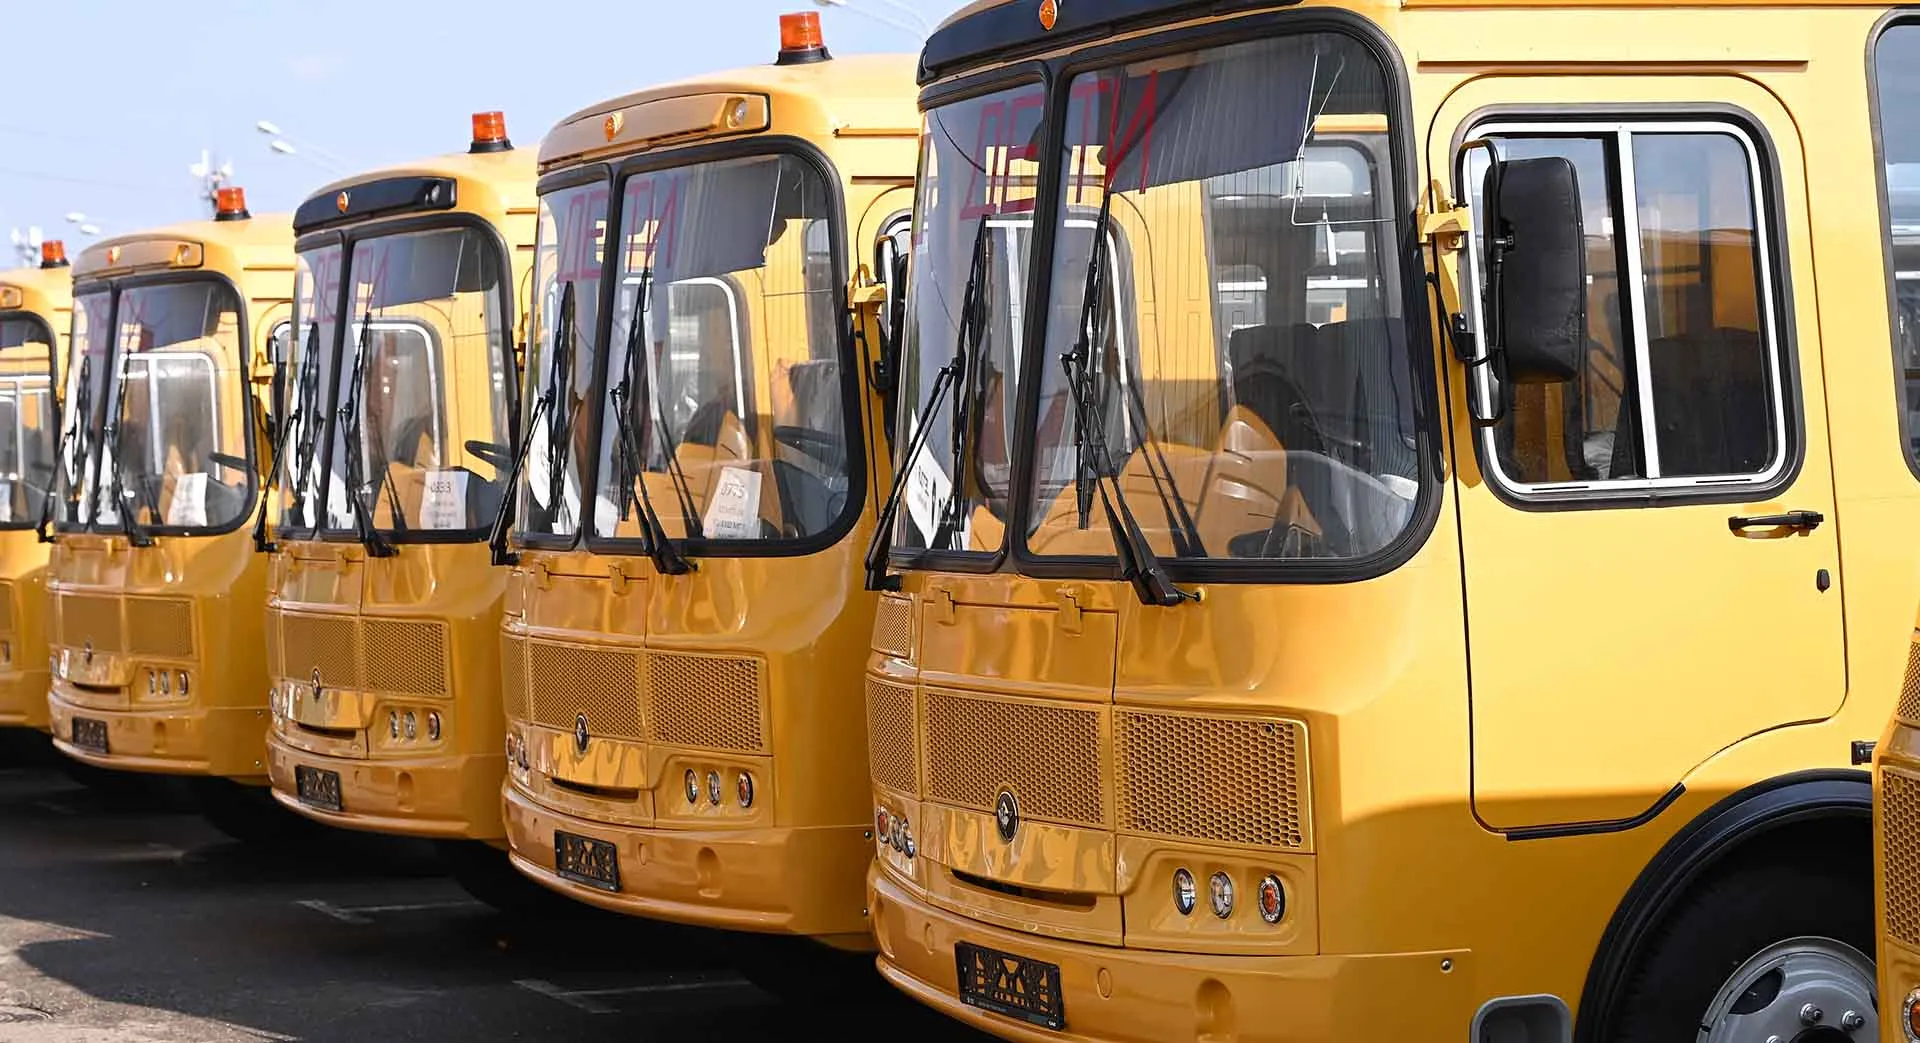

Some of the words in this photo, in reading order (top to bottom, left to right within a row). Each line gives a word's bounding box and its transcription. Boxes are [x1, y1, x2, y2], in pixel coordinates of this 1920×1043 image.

[960, 70, 1159, 220] ДЕТИ
[306, 242, 391, 324] ДЕТИ
[557, 175, 679, 284] ДЕТИ
